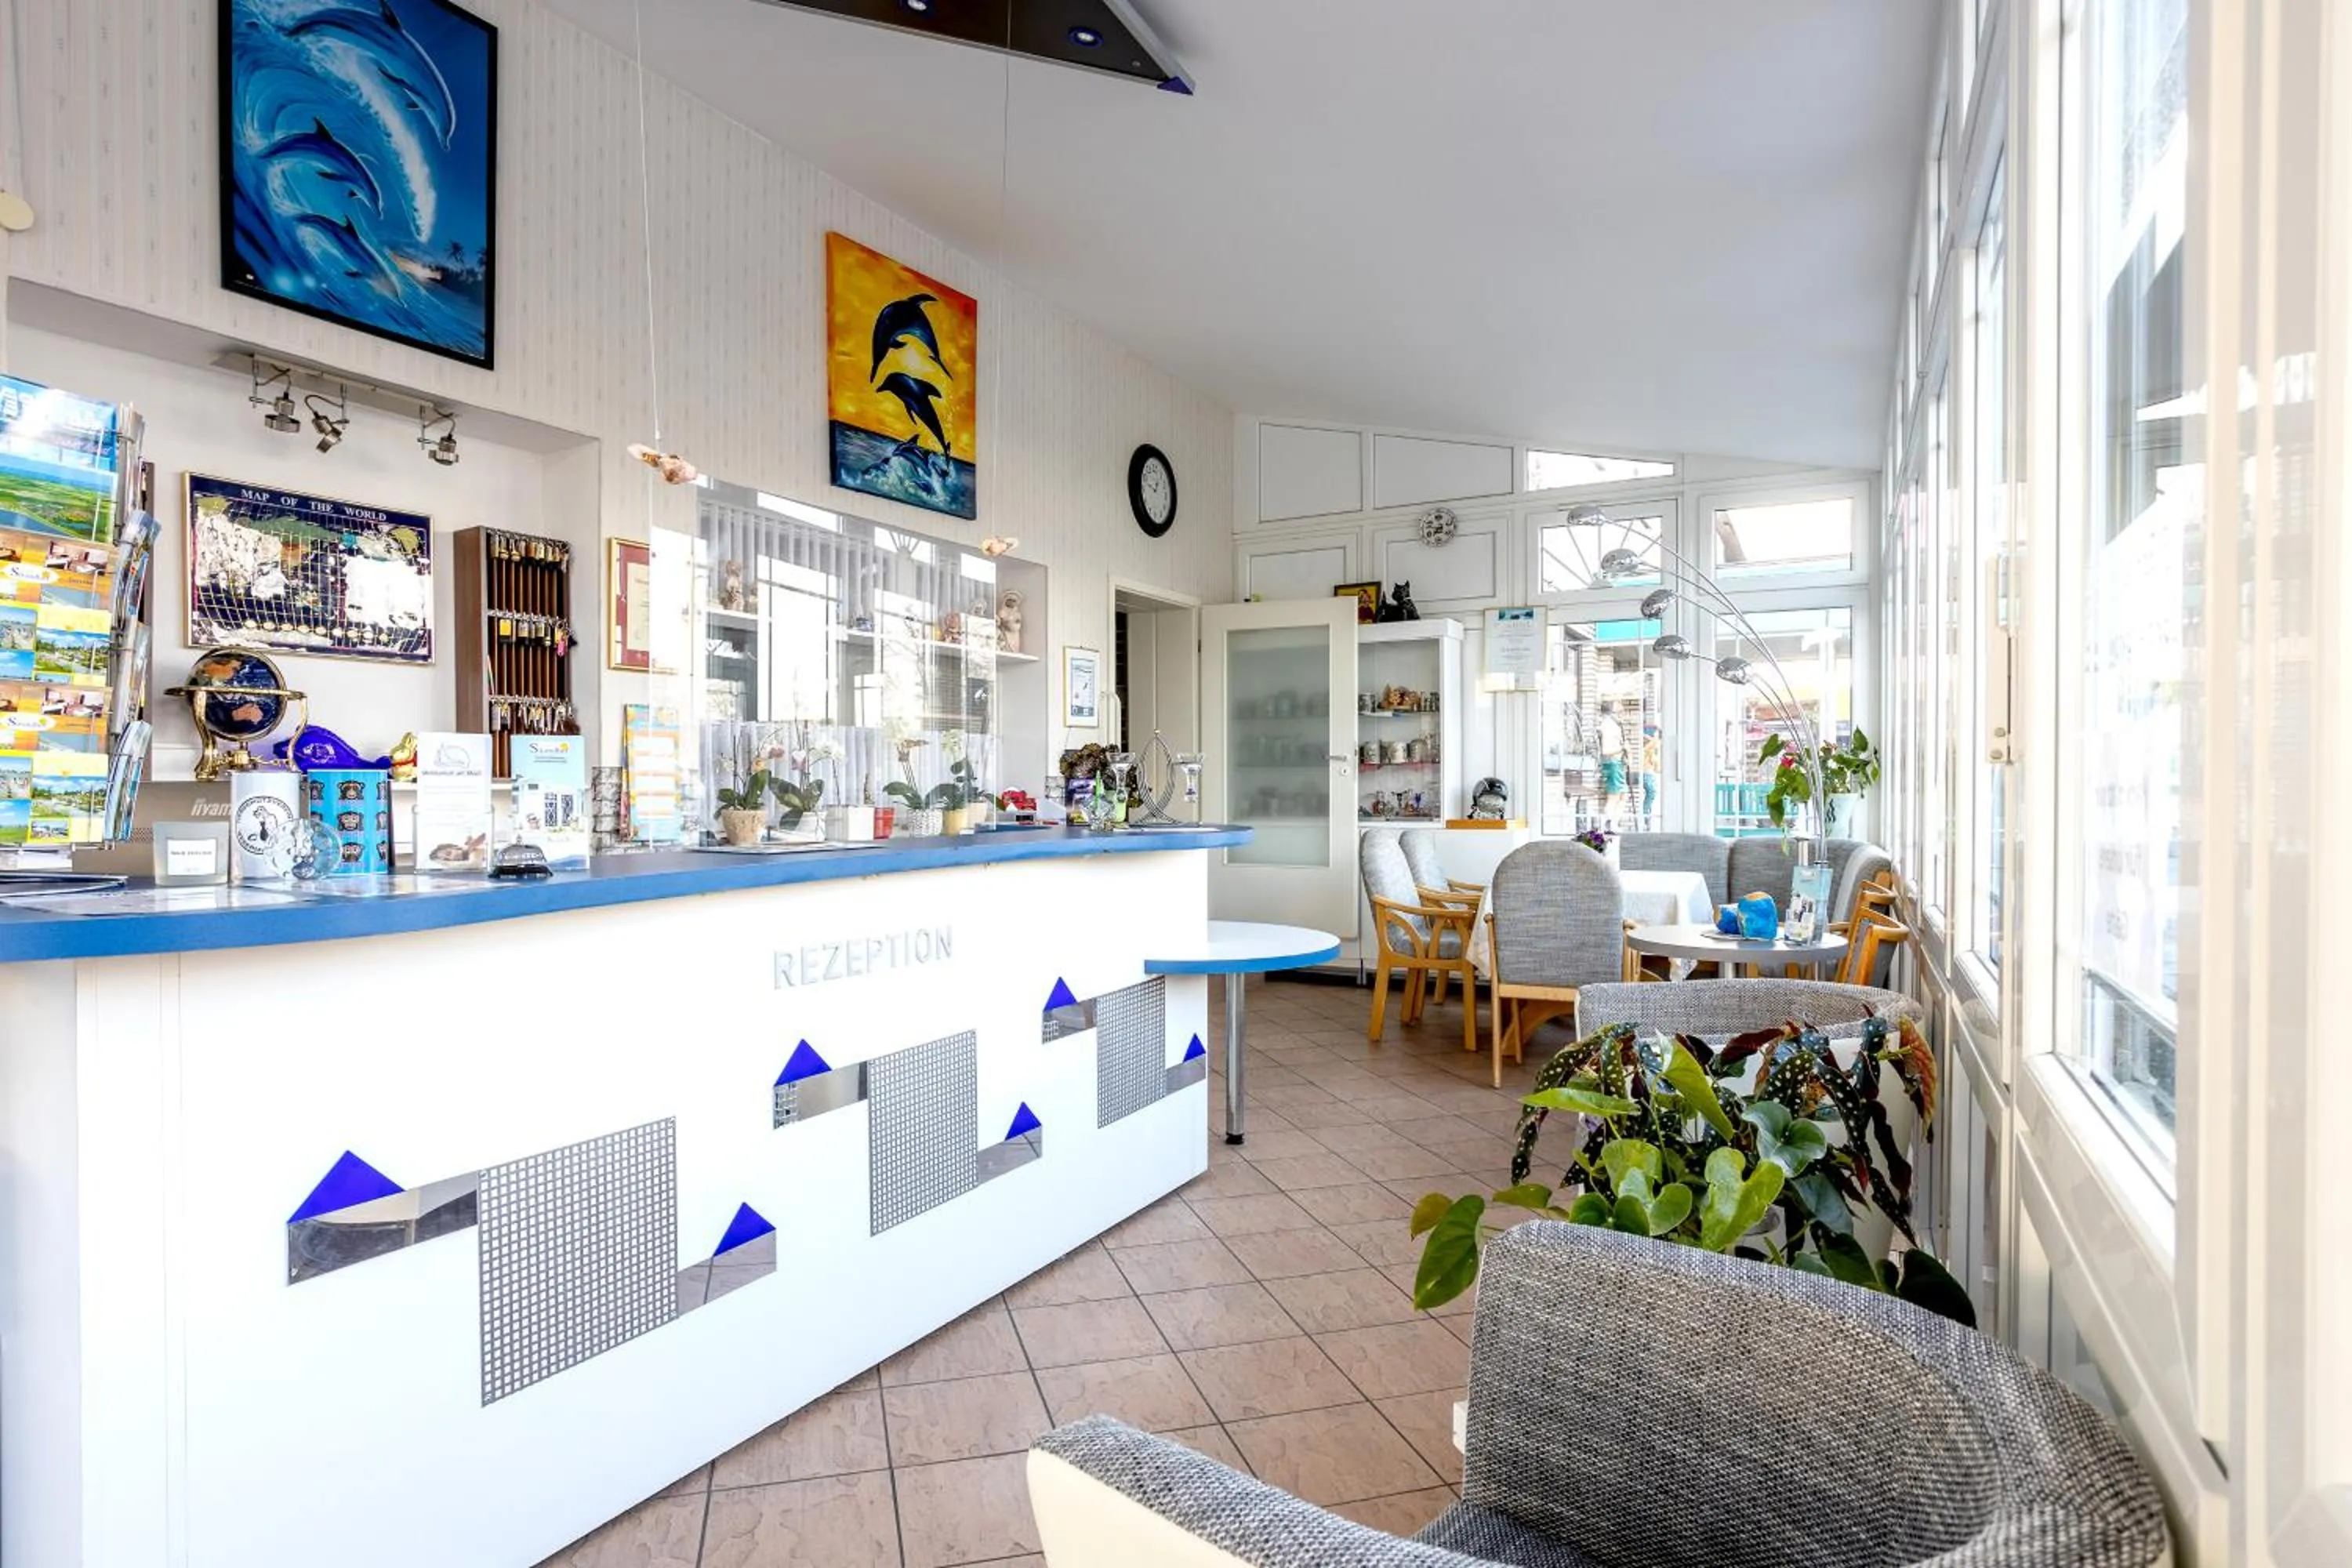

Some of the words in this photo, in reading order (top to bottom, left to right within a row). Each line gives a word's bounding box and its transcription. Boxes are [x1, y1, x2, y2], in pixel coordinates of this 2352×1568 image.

[241, 488, 270, 503] MAP
[280, 495, 299, 507] OF
[308, 500, 333, 514] THE
[343, 506, 387, 522] WORLD
[774, 924, 953, 990] REZEPTION
